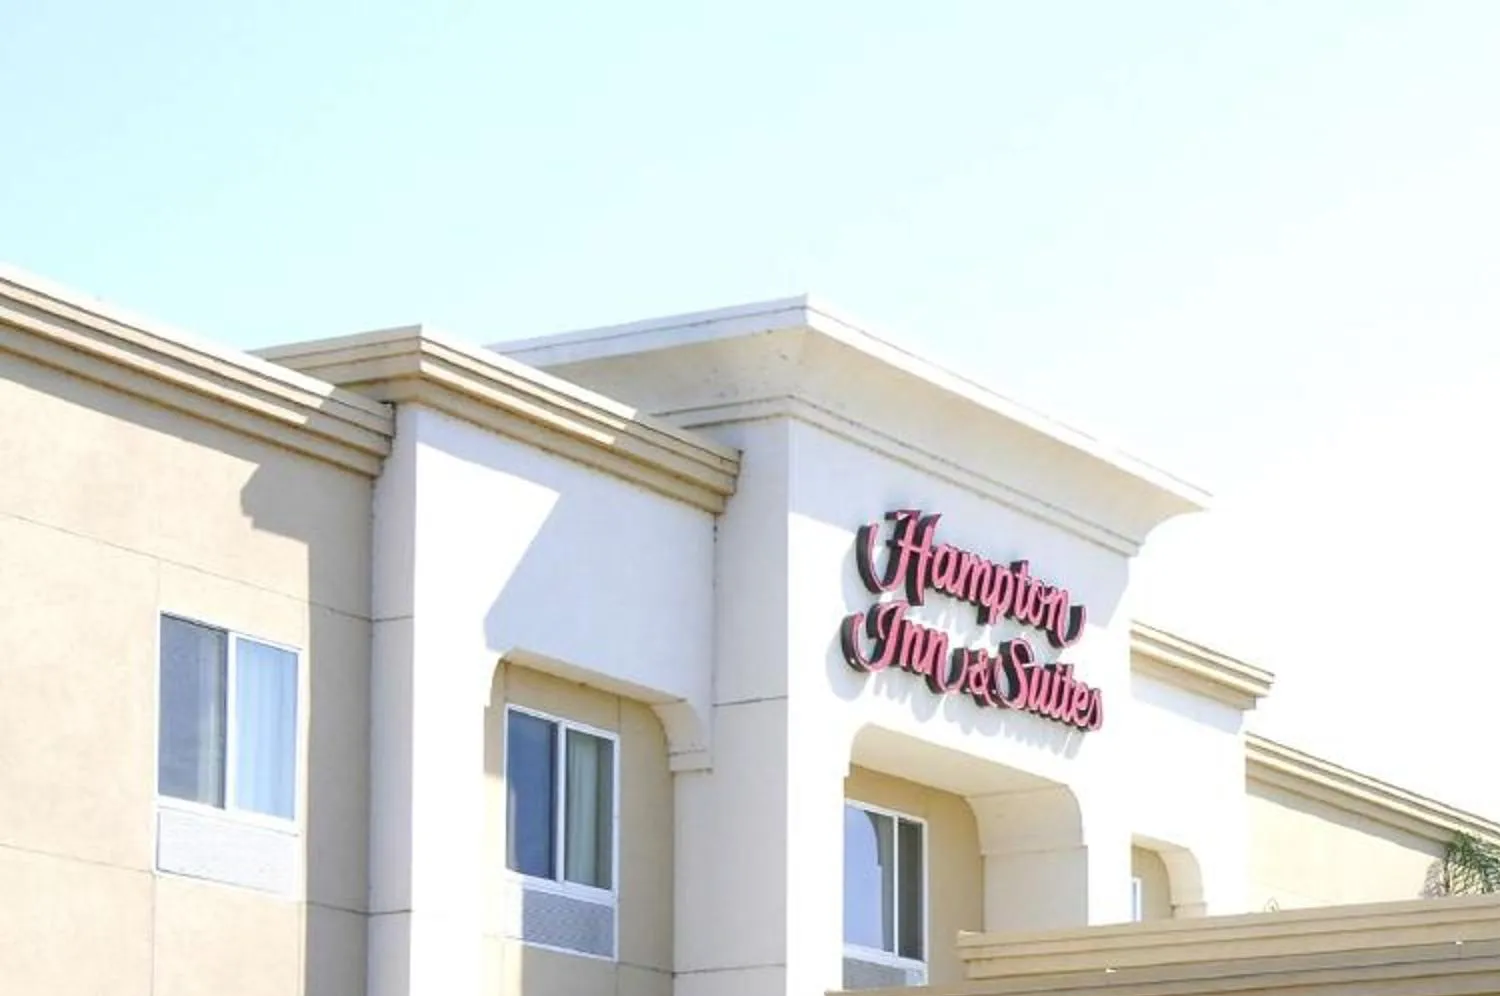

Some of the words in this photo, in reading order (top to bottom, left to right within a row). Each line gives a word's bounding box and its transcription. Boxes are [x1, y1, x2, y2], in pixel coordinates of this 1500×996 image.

[856, 509, 1085, 648] Hampton
[841, 601, 968, 694] Inn
[967, 648, 999, 707] &
[994, 637, 1103, 731] Suites
